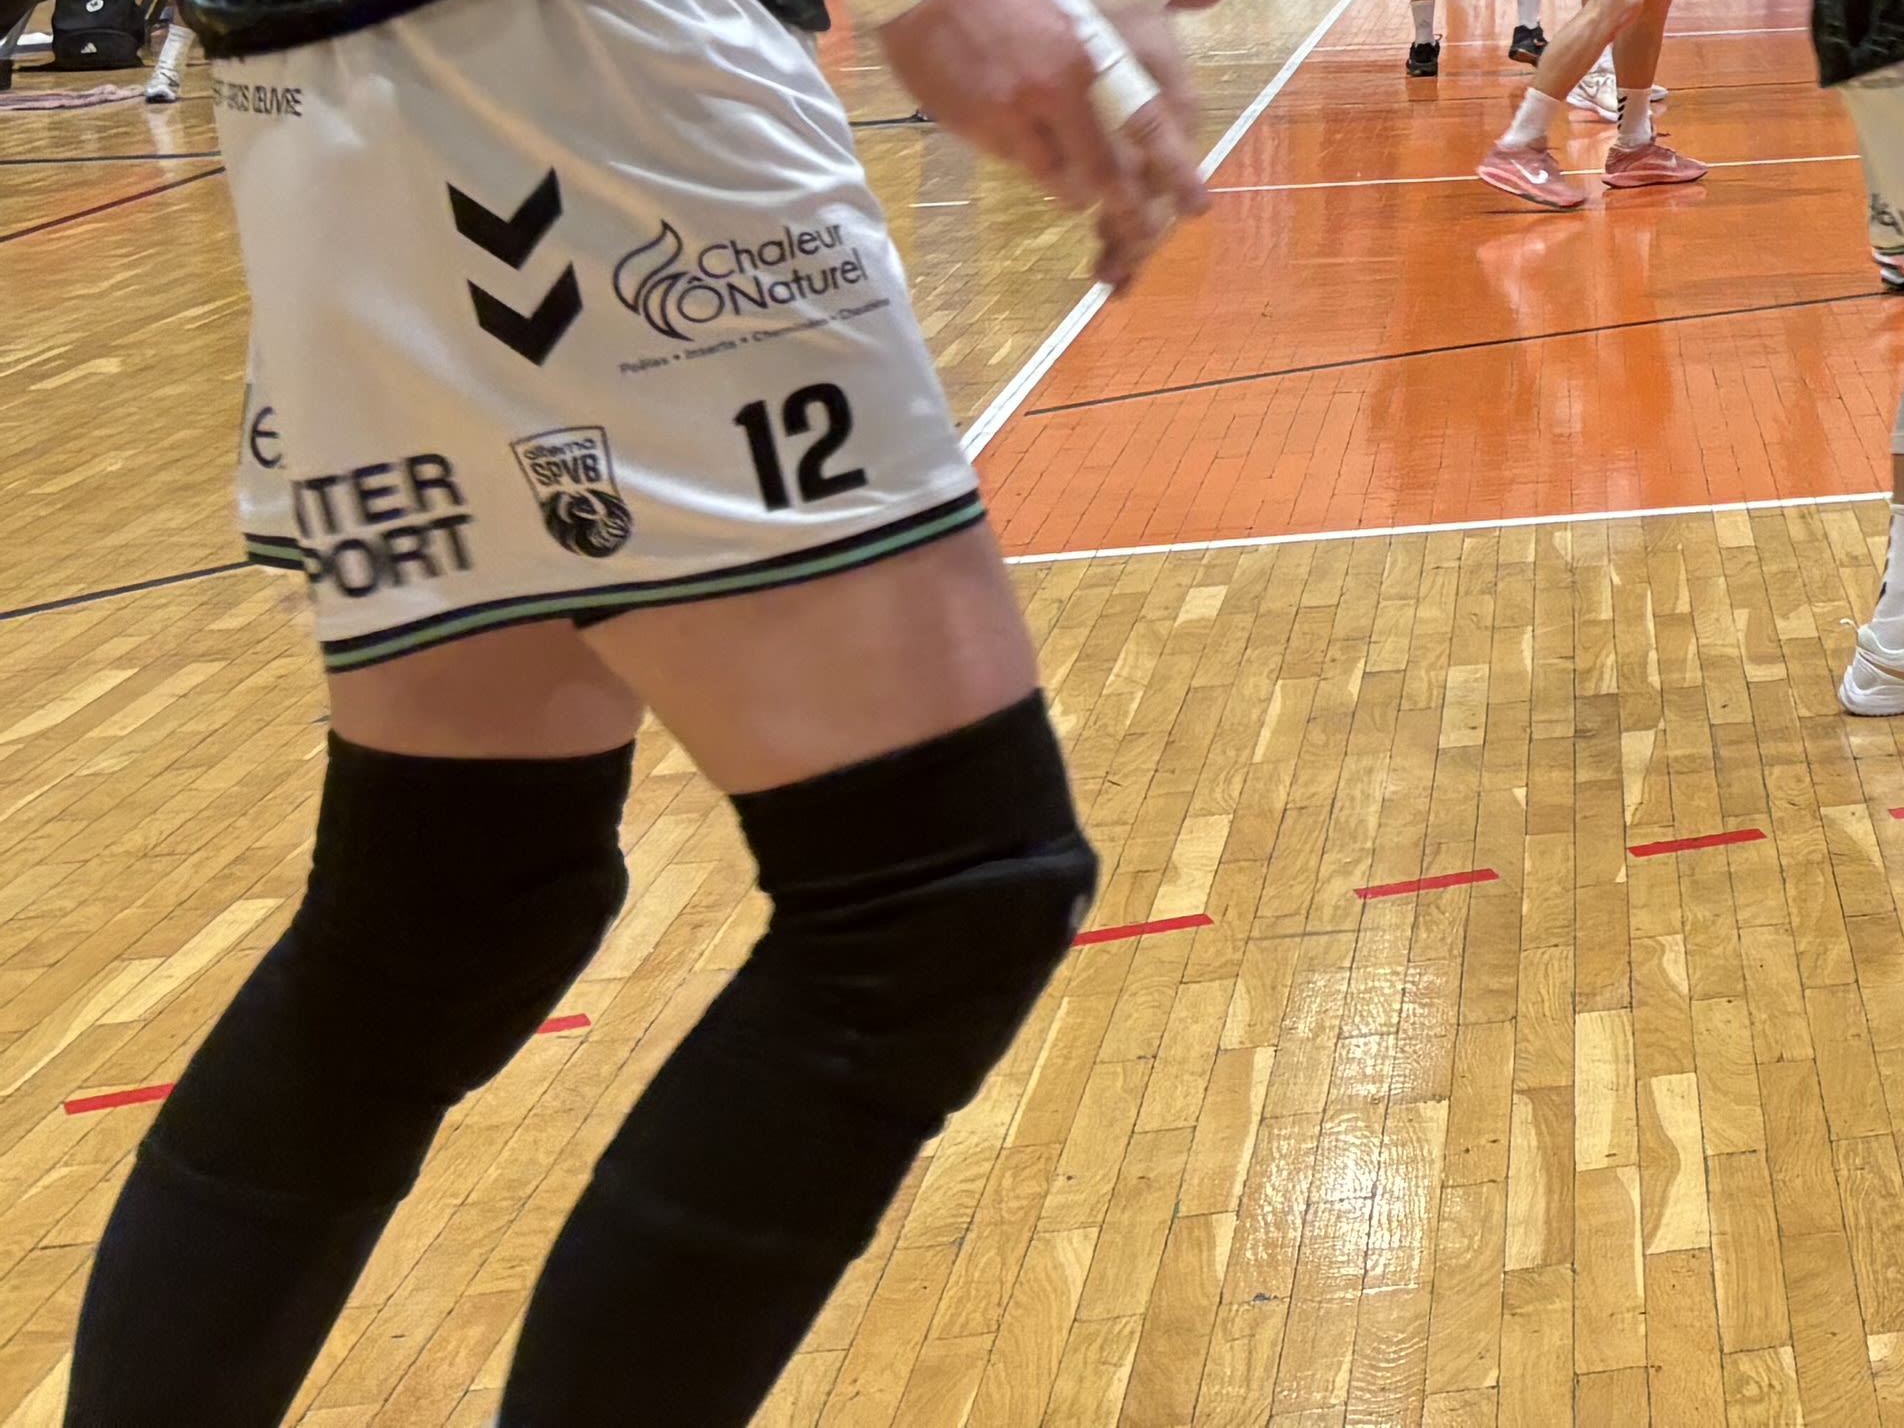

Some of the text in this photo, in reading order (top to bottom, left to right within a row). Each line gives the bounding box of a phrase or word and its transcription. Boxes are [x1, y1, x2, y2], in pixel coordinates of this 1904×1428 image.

[698, 223, 844, 279] Chaleur
[530, 453, 602, 487] SPVB
[733, 382, 870, 513] 12
[292, 452, 466, 539] TER
